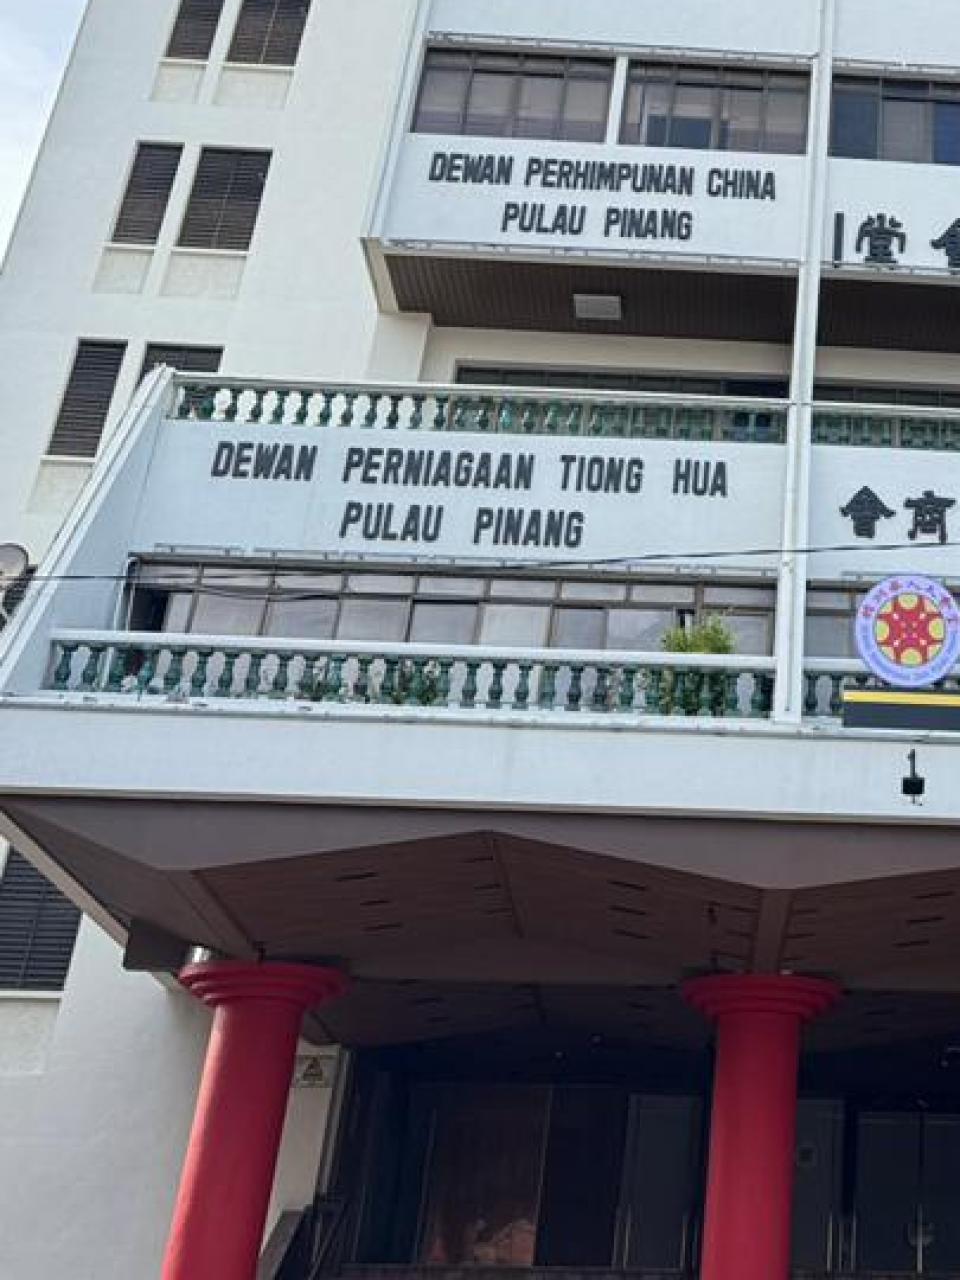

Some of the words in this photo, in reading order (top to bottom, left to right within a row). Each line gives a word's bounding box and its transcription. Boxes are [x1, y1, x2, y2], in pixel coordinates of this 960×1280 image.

[428, 152, 513, 186] DEWAN
[523, 157, 695, 196] PERHIMPUNAN
[706, 167, 776, 200] CHINA
[501, 202, 586, 236] PULAU
[603, 207, 693, 241] PINANG
[210, 441, 317, 482] DEWAN
[342, 447, 535, 490] PERNIAGAAN
[560, 454, 644, 494] TIONG
[672, 459, 728, 498] HUA
[338, 501, 444, 543] PULAU
[473, 507, 584, 549] PINANG
